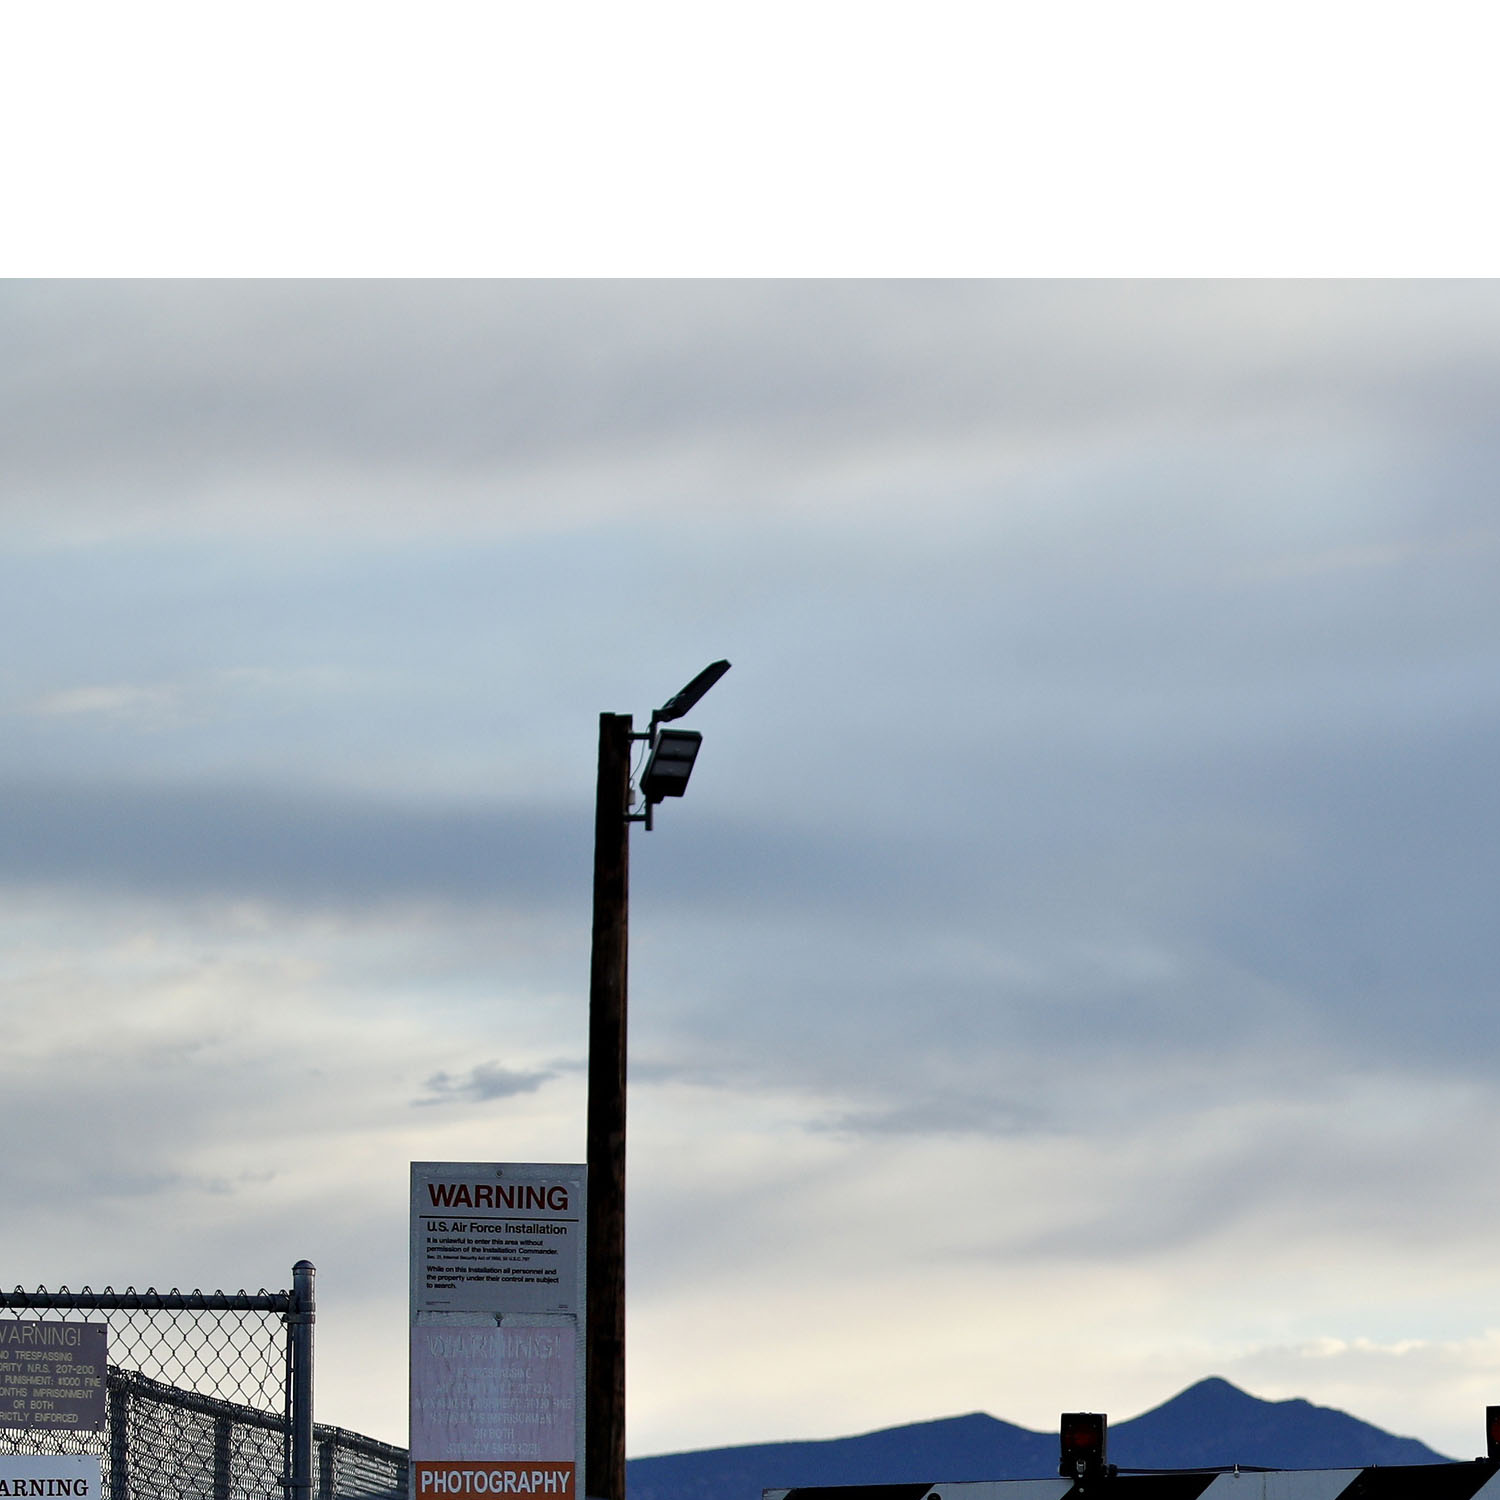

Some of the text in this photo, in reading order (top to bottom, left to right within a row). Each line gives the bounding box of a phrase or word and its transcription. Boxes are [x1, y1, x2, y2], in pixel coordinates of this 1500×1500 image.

[428, 1183, 568, 1211] WARNING
[427, 1221, 567, 1235] U.S. Air Force Installation
[15, 1350, 73, 1362] TRESPASSING
[84, 1377, 102, 1387] FINE
[32, 1388, 94, 1399] IMPRISONMENT
[13, 1399, 54, 1410] OR BOTH
[34, 1412, 79, 1423] ENFORCED
[421, 1470, 571, 1494] PHOTOGRAPHY
